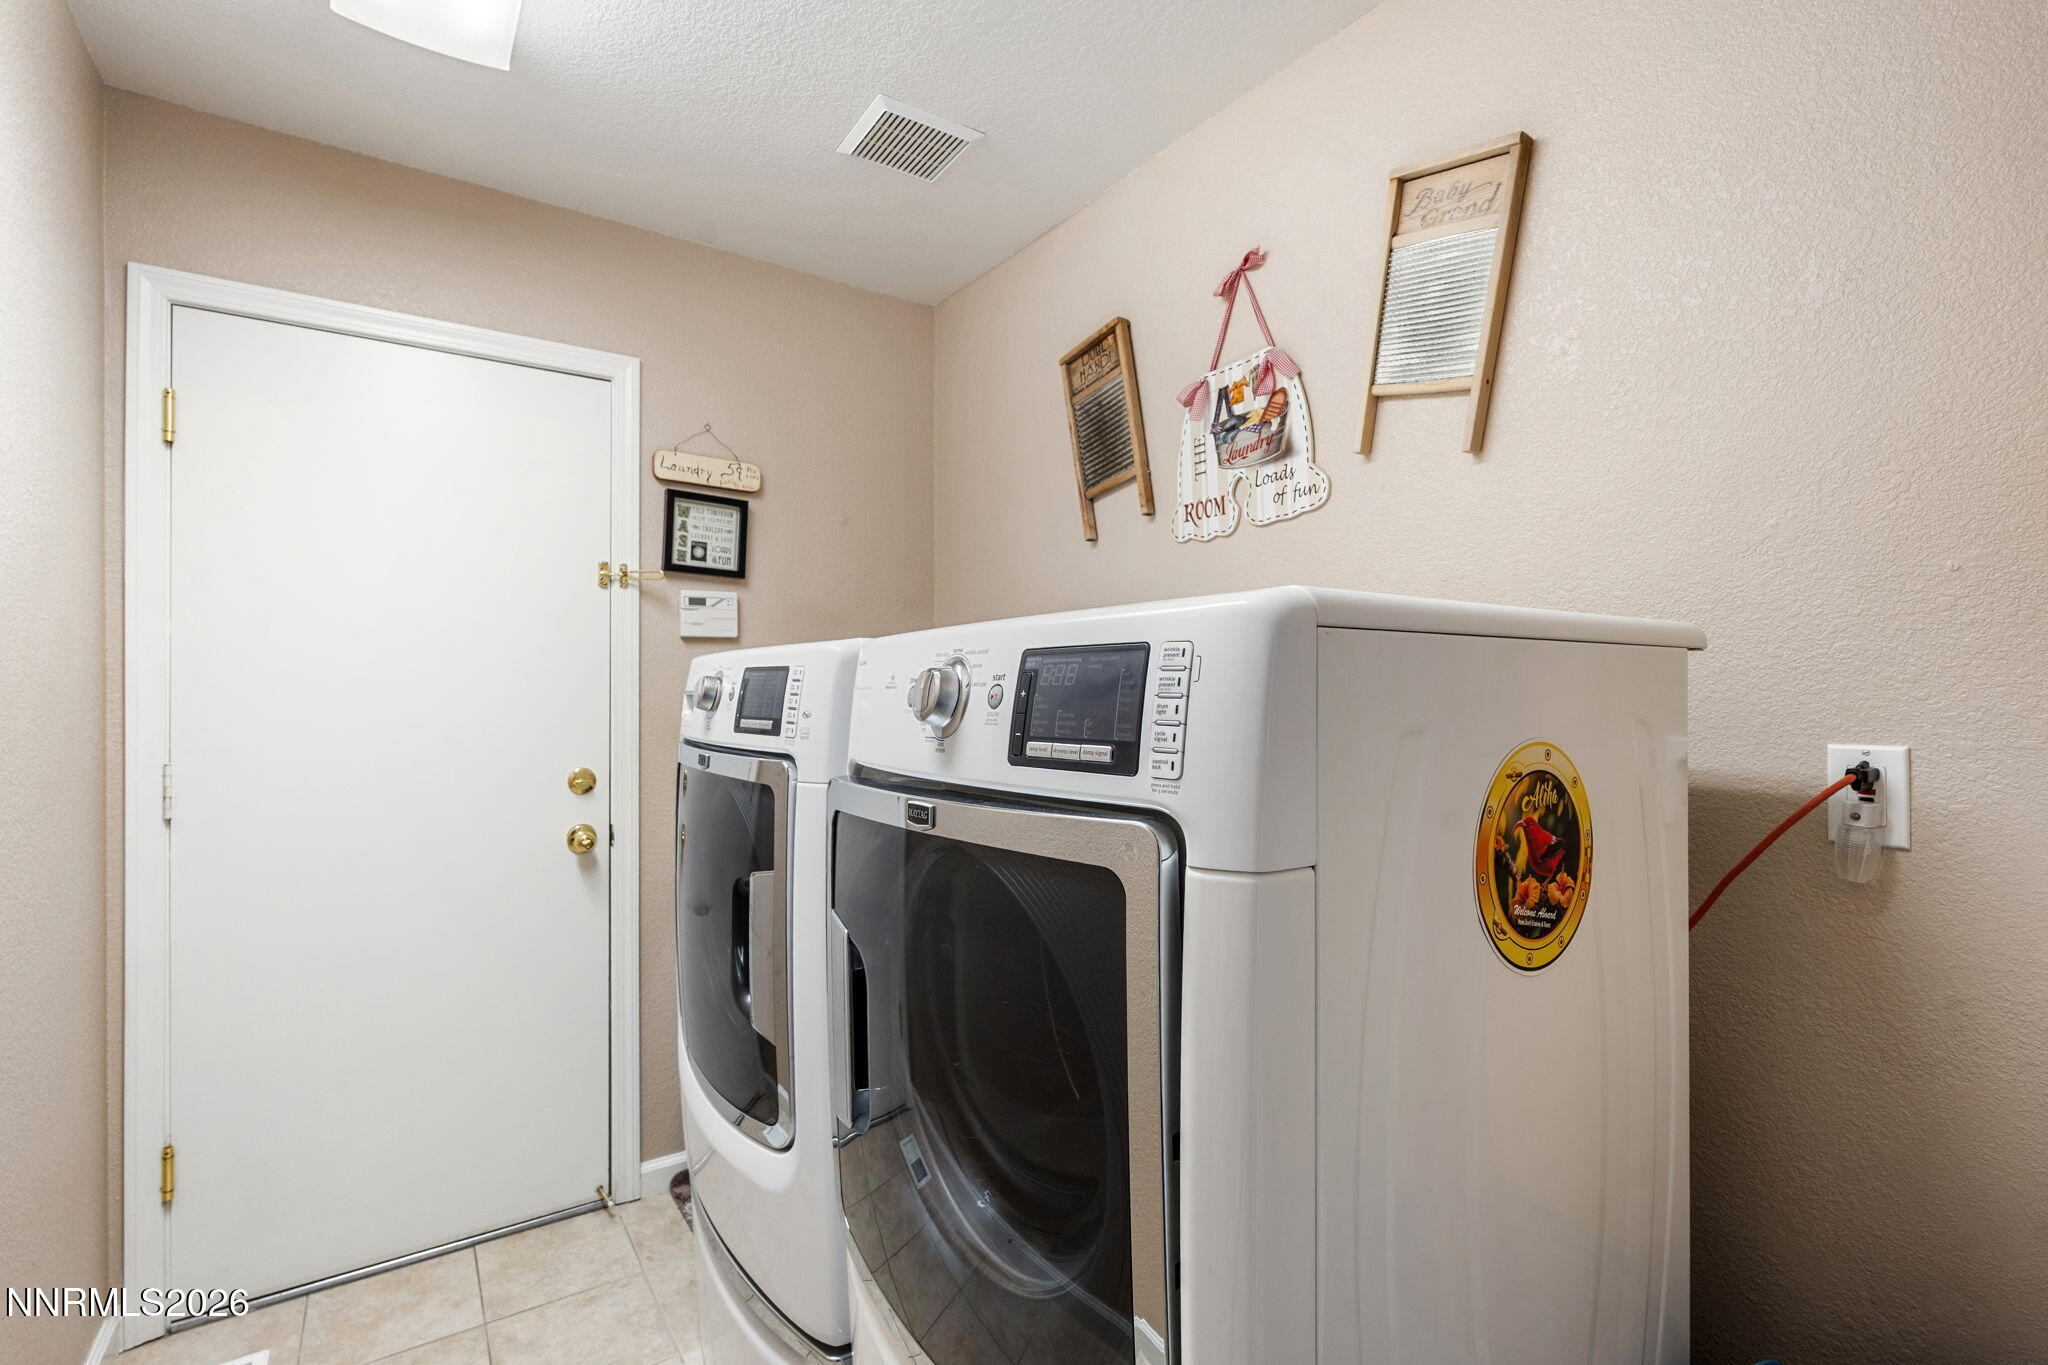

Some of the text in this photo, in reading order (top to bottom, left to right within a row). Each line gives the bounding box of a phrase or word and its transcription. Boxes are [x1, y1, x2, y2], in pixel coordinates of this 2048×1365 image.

[1404, 179, 1492, 217] Baby
[1420, 181, 1503, 227] Grand
[1193, 434, 1207, 482] THE
[1223, 432, 1274, 465] Laundry
[660, 455, 713, 485] Laundry
[1255, 463, 1296, 488] Loads
[1273, 482, 1321, 506] of fun
[1183, 495, 1227, 529] ROOM
[676, 503, 691, 562] WASH
[992, 673, 1006, 682] start
[1522, 780, 1558, 811] Aloha
[908, 808, 928, 820] MAYTAG
[1514, 904, 1558, 920] Welcome Aboard
